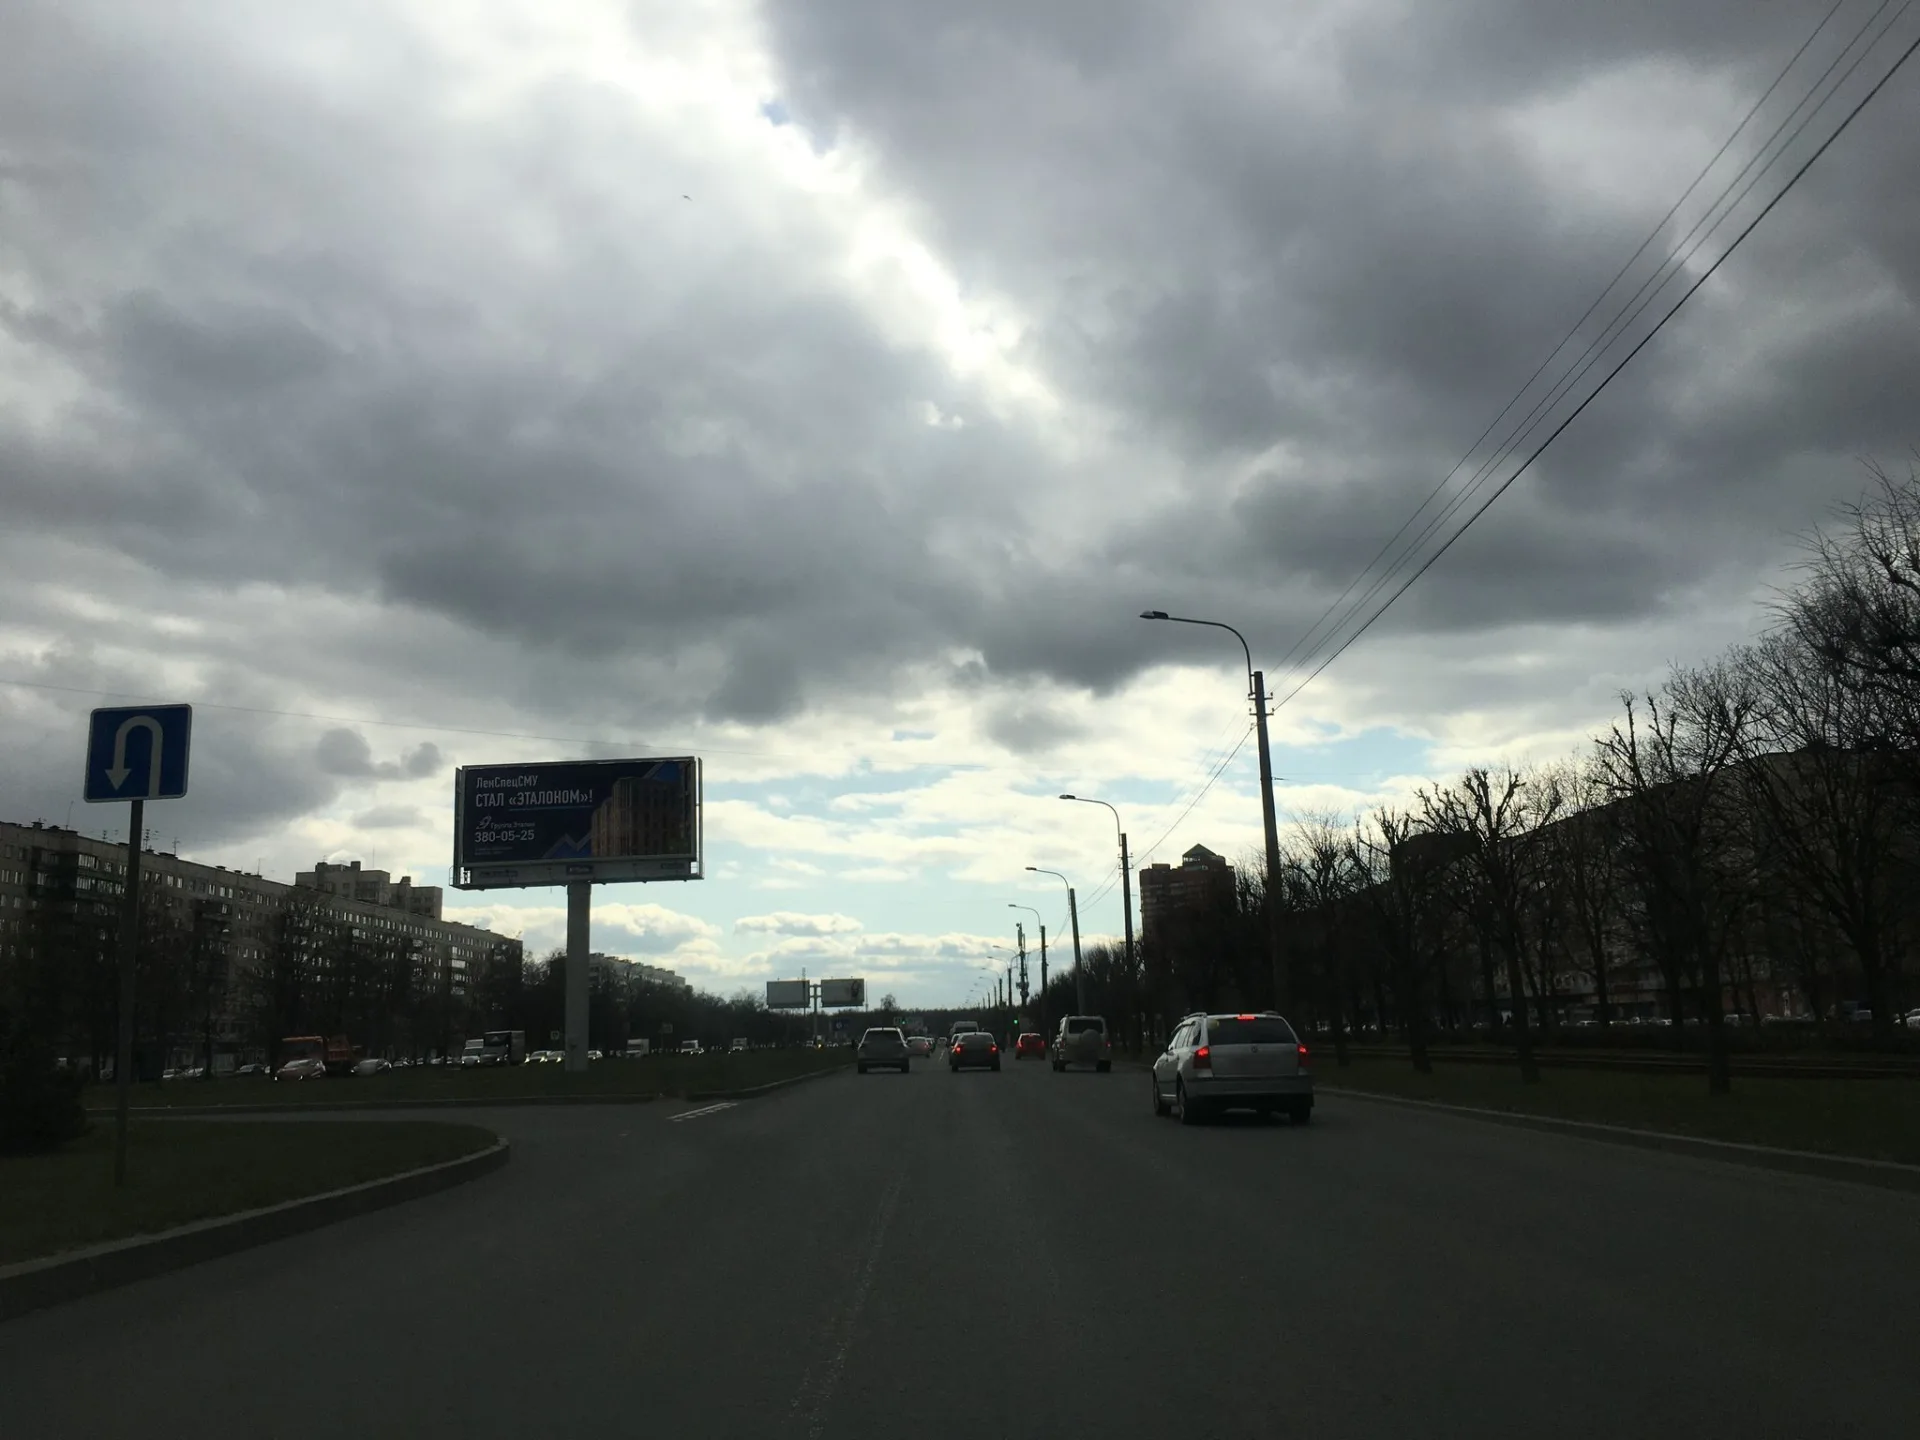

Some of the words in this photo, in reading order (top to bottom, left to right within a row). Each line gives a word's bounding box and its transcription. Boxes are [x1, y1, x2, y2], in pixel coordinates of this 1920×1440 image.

[476, 775, 539, 789] ЛенСпецСМУ
[475, 792, 505, 808] СТАЛ
[508, 789, 593, 806] «ЭТАЛОНОМ»!
[474, 829, 535, 843] 380-05-25
